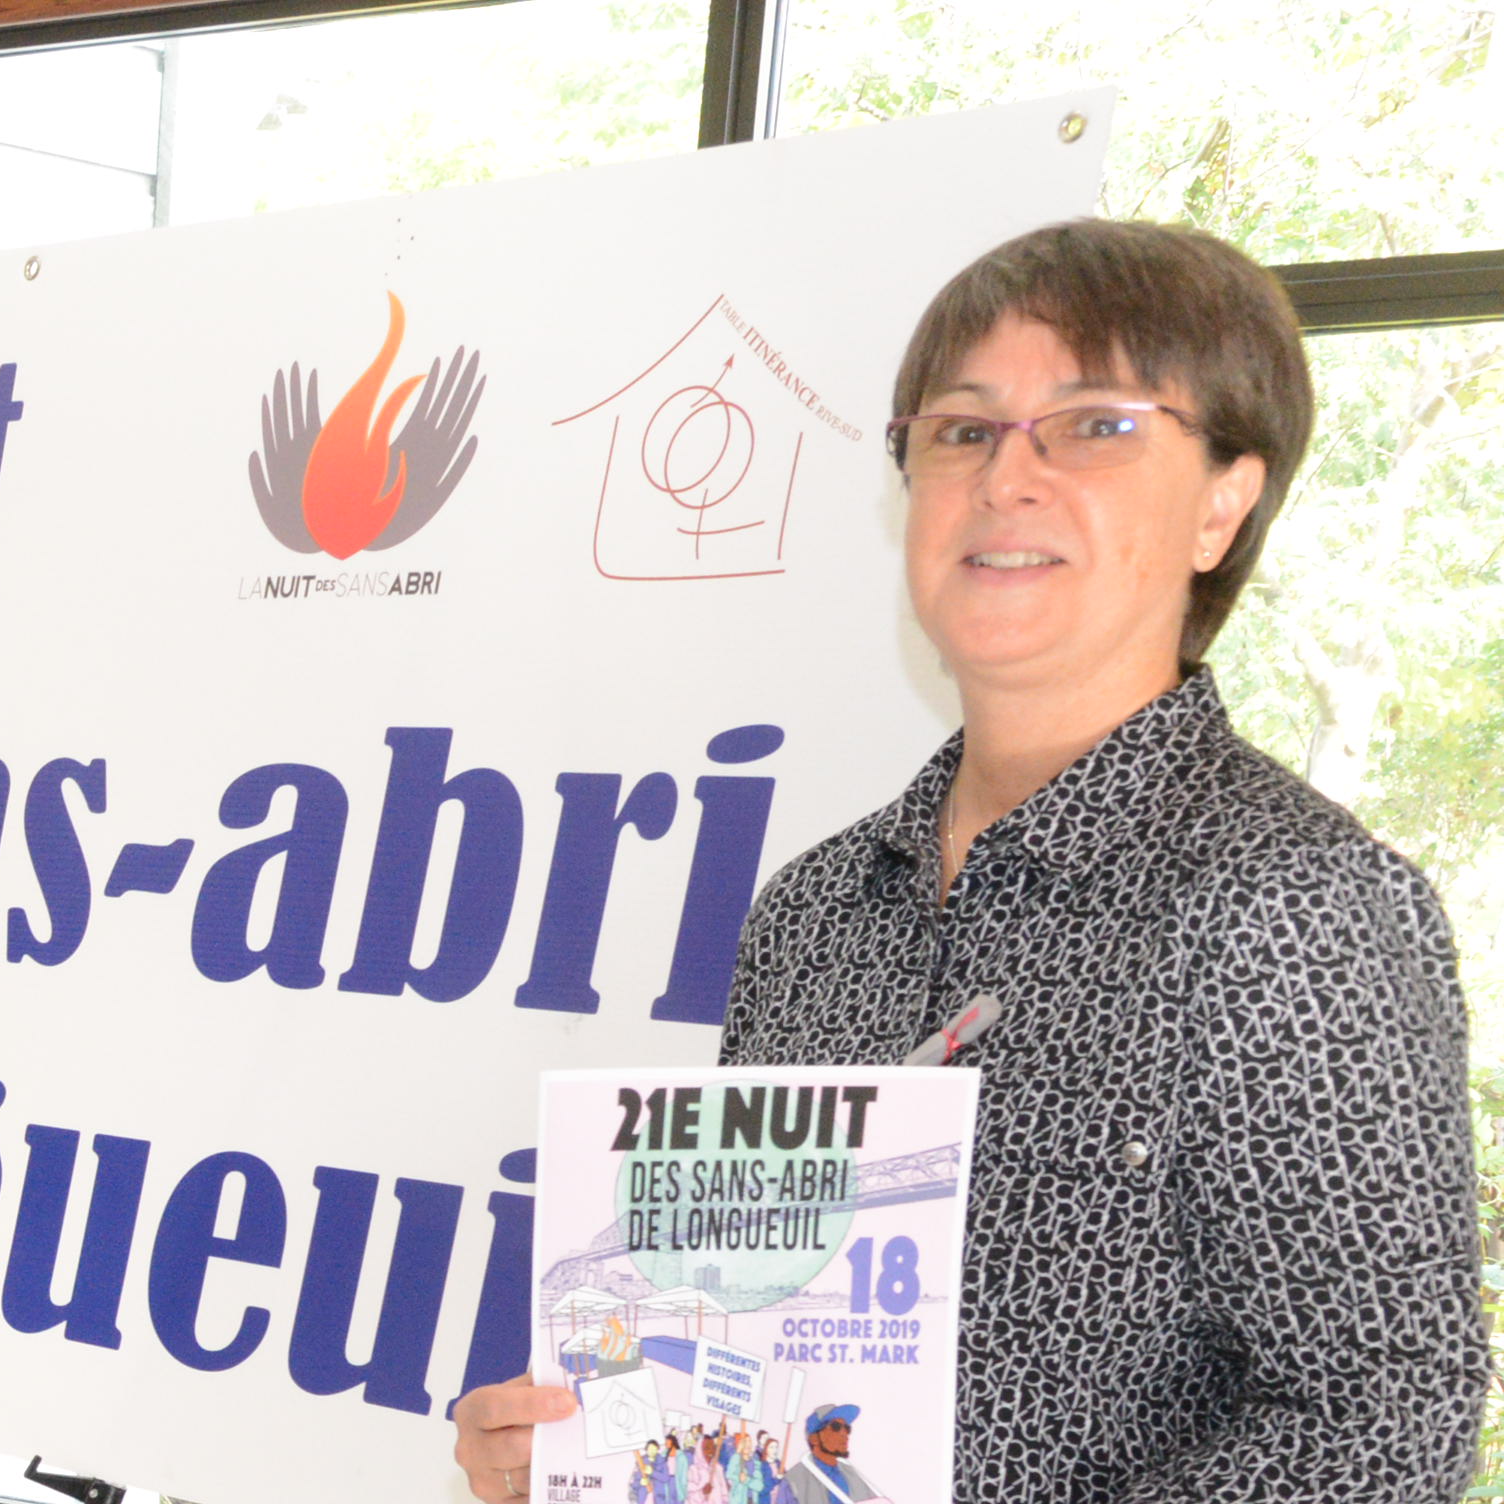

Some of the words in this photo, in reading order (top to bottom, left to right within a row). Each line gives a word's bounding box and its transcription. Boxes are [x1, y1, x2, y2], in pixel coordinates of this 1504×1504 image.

[719, 298, 747, 333] TABLE
[743, 326, 820, 411] ITINÉRANCE
[815, 404, 863, 442] RIVE-SUD
[610, 1086, 703, 1151] 21E
[719, 1085, 879, 1150] NUIT
[630, 1160, 682, 1203] DES
[691, 1159, 849, 1202] SANS-ABRI
[628, 1208, 662, 1251] DE
[671, 1208, 827, 1251] LONGUEUIL
[846, 1235, 921, 1316] 18
[782, 1318, 873, 1339] OCTOBRE
[878, 1319, 921, 1339] 2019
[773, 1342, 823, 1363] PARC
[827, 1343, 855, 1364] ST.
[860, 1344, 919, 1365] MARK
[547, 1474, 568, 1488] 18H
[582, 1476, 603, 1489] 22H
[547, 1488, 581, 1503] VILLAGE
